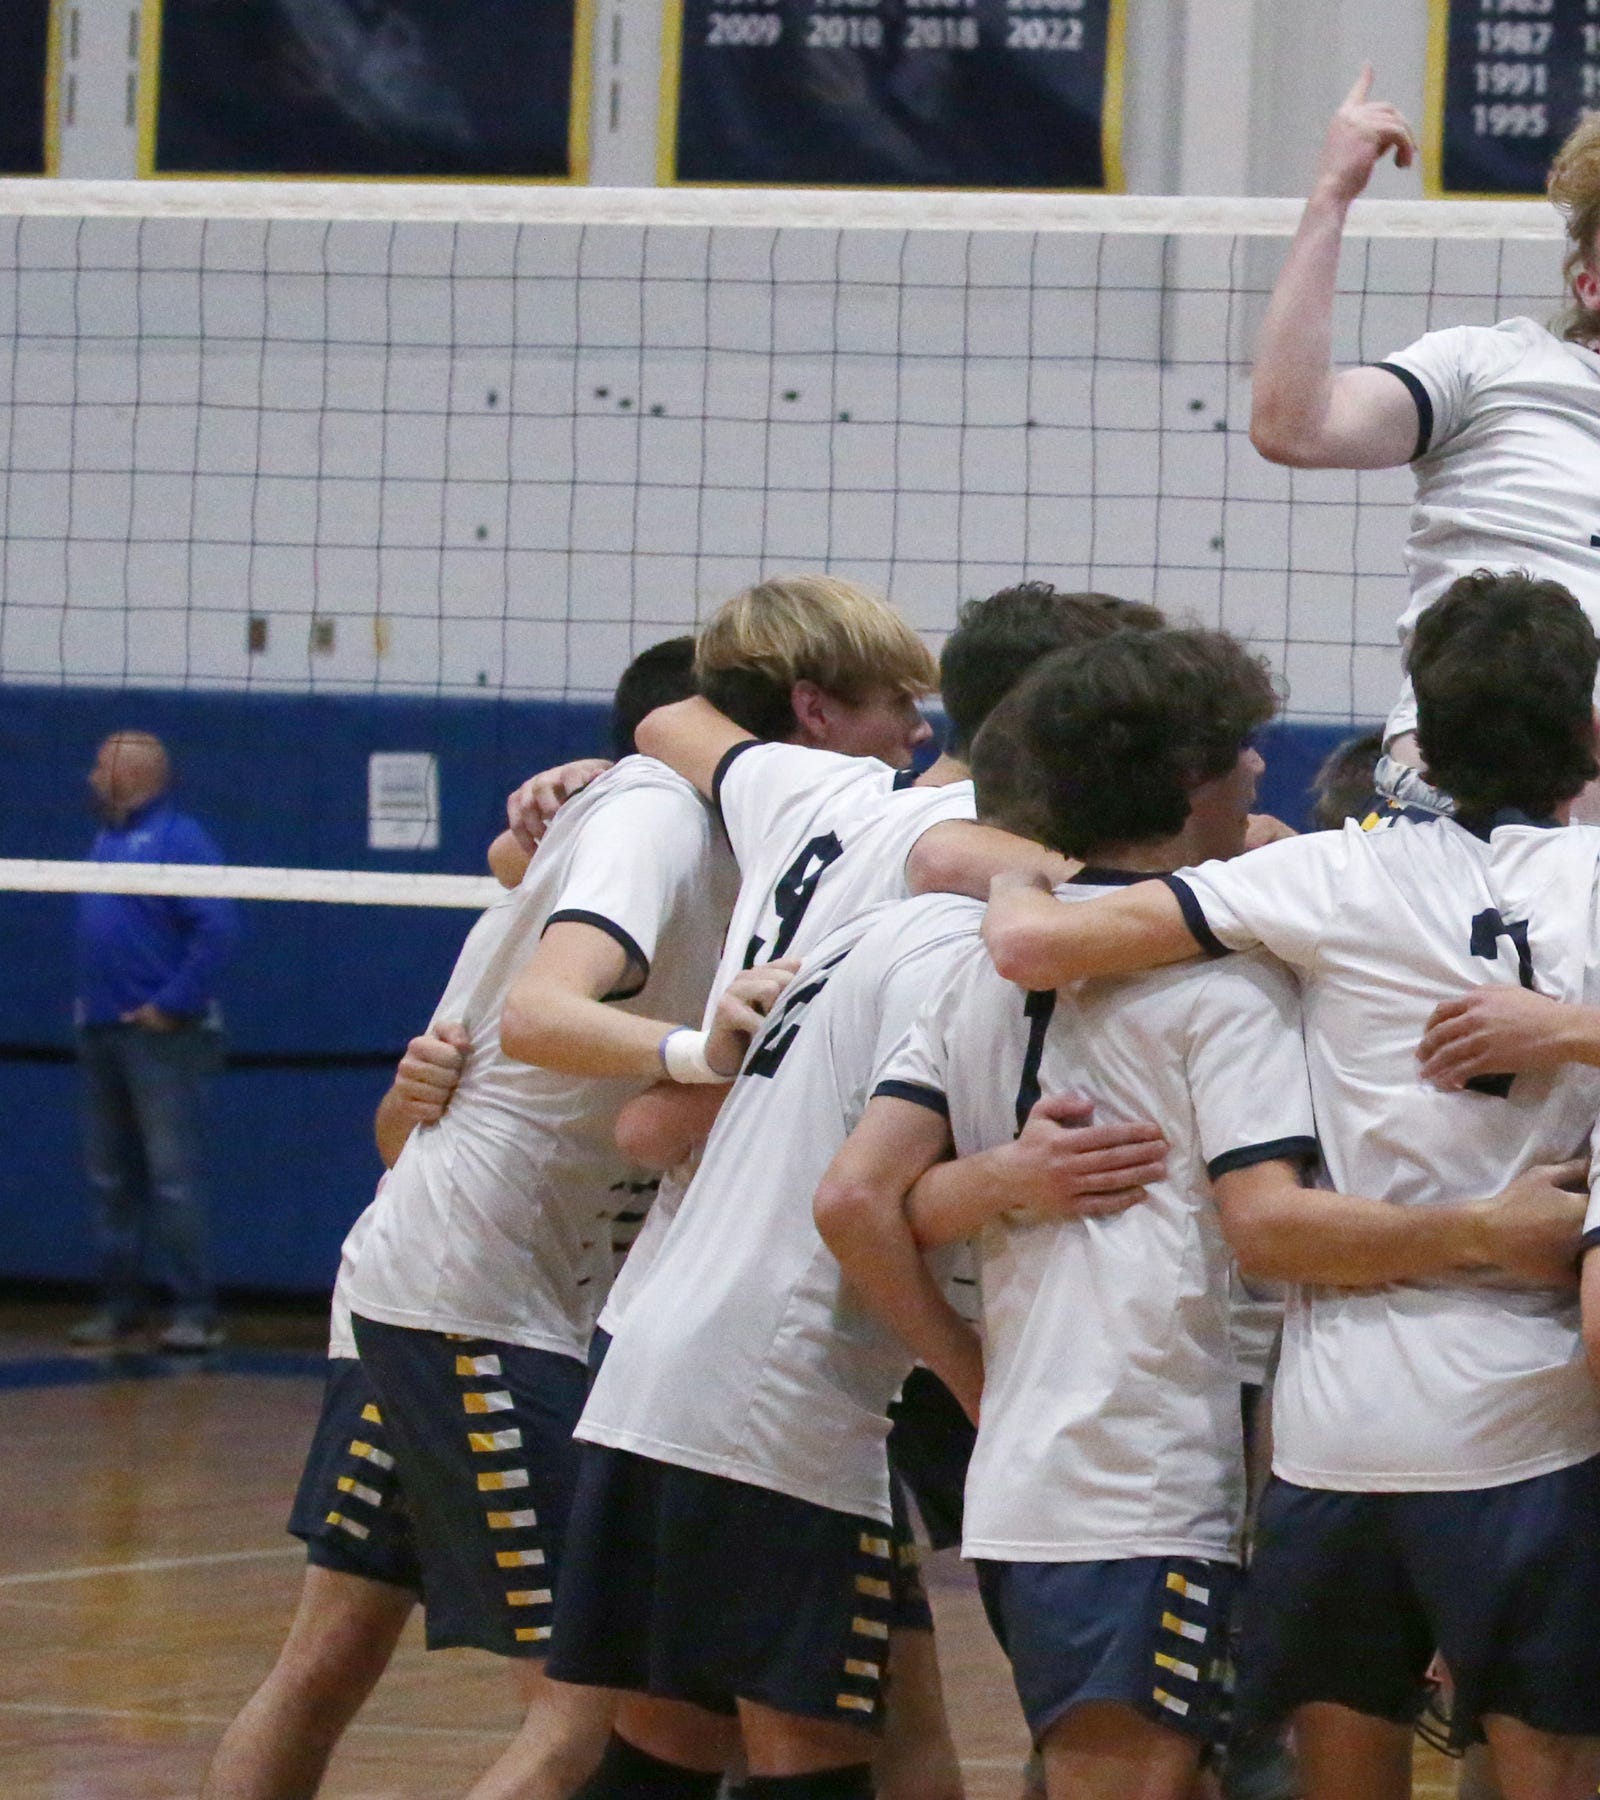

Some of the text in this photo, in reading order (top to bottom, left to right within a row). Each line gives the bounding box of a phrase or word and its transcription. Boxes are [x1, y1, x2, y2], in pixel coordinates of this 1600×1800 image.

[707, 14, 1082, 50] 2009 2010 2018 2022
[1476, 22, 1553, 54] 1987
[1474, 63, 1547, 95] 1991
[1471, 104, 1547, 137] 1995
[743, 830, 843, 970] 9
